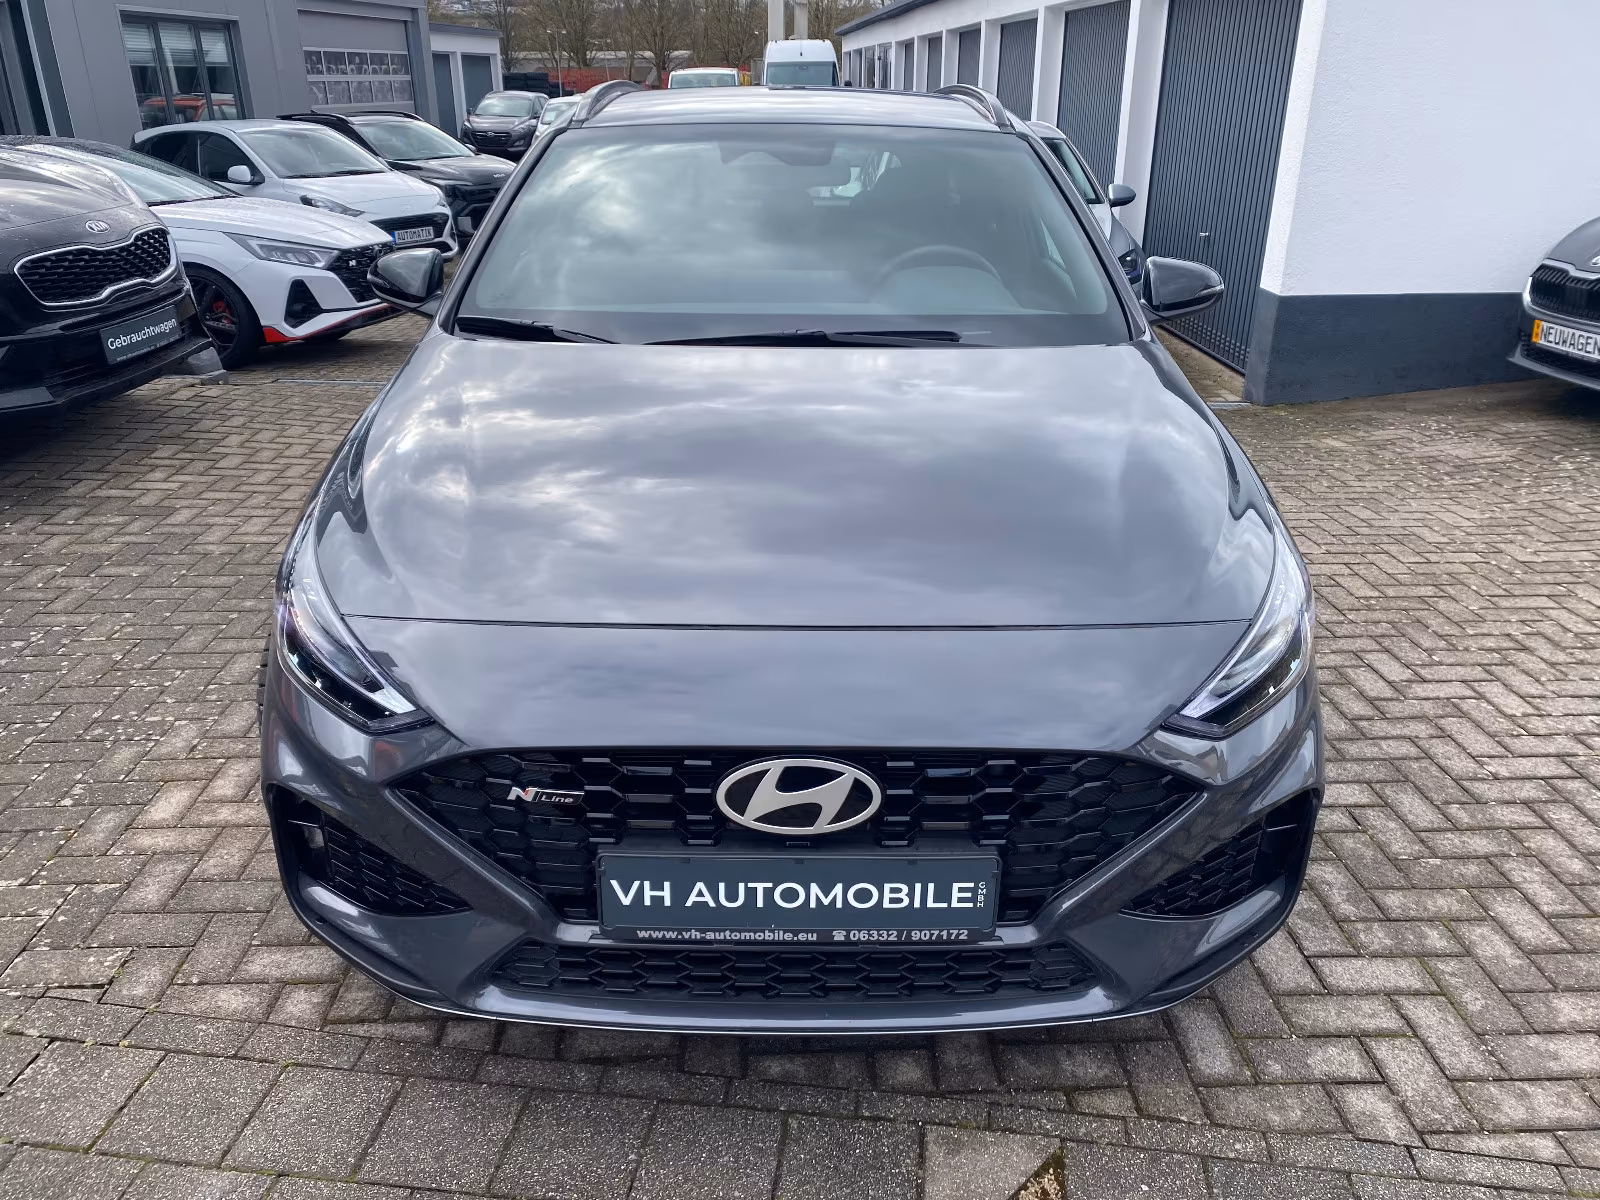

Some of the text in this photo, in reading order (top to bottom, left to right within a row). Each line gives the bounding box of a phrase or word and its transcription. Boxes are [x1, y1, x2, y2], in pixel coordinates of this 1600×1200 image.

[89, 221, 108, 232] KIA
[397, 229, 432, 241] AUTOMATIK
[107, 318, 177, 350] Gebrauchtwagen
[1542, 323, 1600, 356] NEUWAGEN
[541, 794, 574, 803] Line
[609, 879, 975, 909] VH AUTOMOBILE
[636, 929, 817, 941] www.vh-automobile.eu
[849, 930, 898, 941] 06332
[911, 929, 968, 941] 907172
